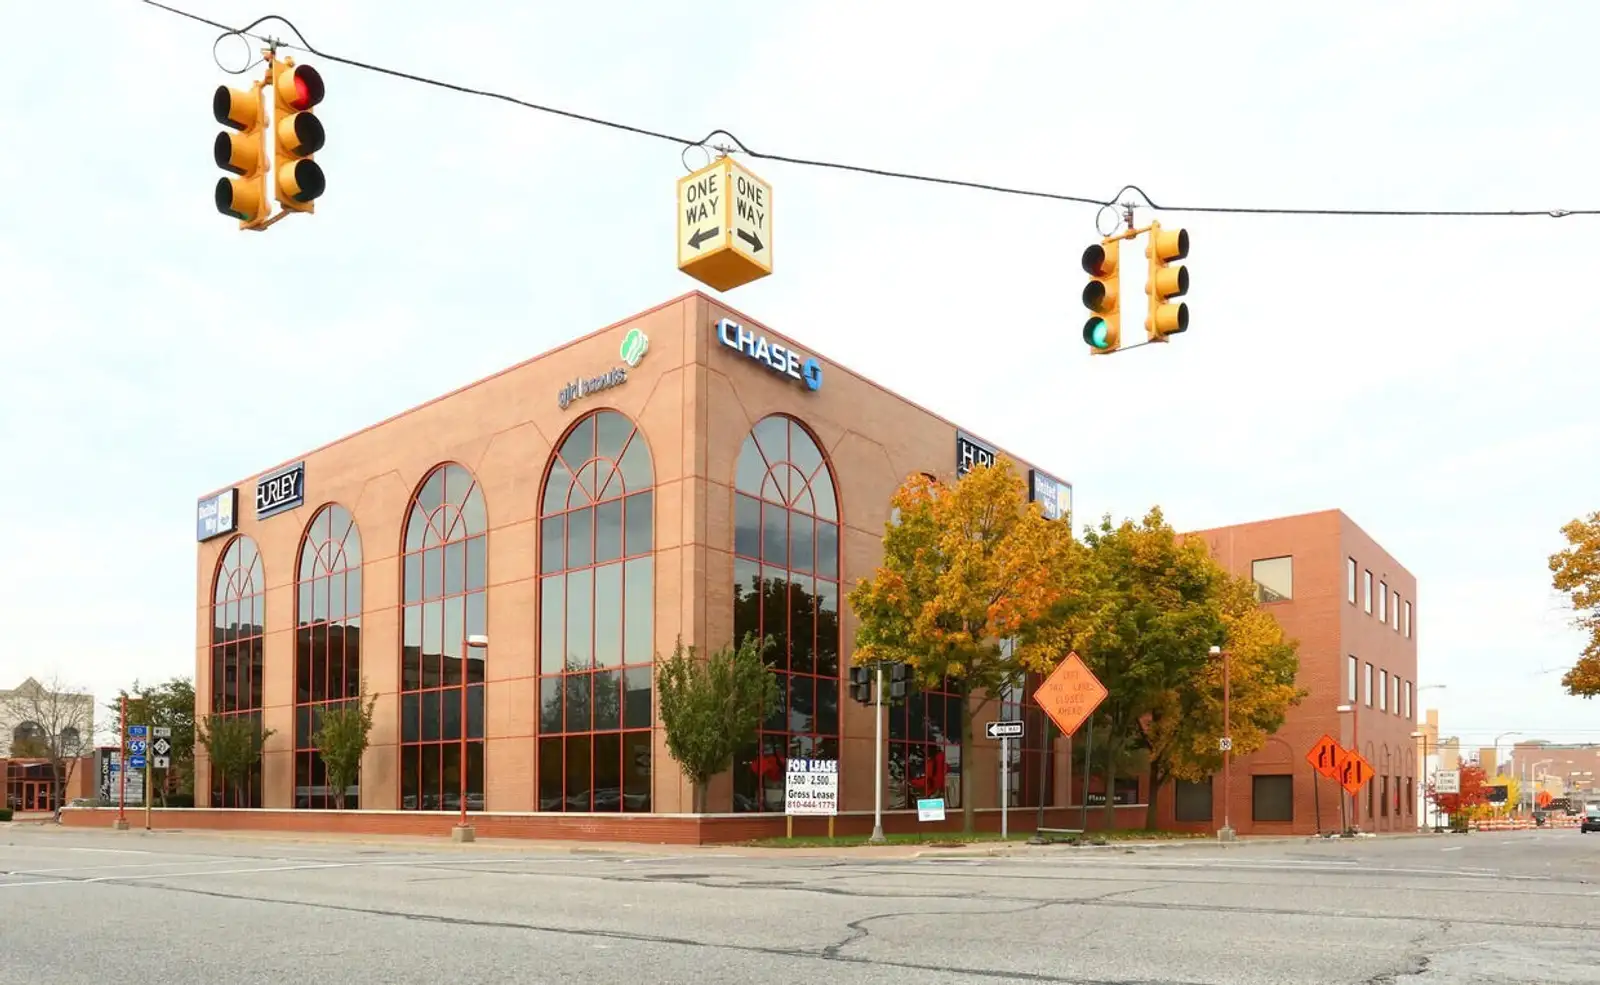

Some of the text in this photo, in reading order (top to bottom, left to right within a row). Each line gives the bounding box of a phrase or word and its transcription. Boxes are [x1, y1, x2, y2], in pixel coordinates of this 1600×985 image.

[687, 174, 717, 203] ONE
[737, 176, 763, 207] ONE
[686, 196, 719, 226] WAY
[737, 196, 764, 229] WAY
[717, 318, 802, 380] CHASE
[558, 377, 582, 411] girl
[131, 741, 146, 753] 69
[788, 759, 838, 772] FOR LEASE
[788, 789, 835, 799] Gross Lease
